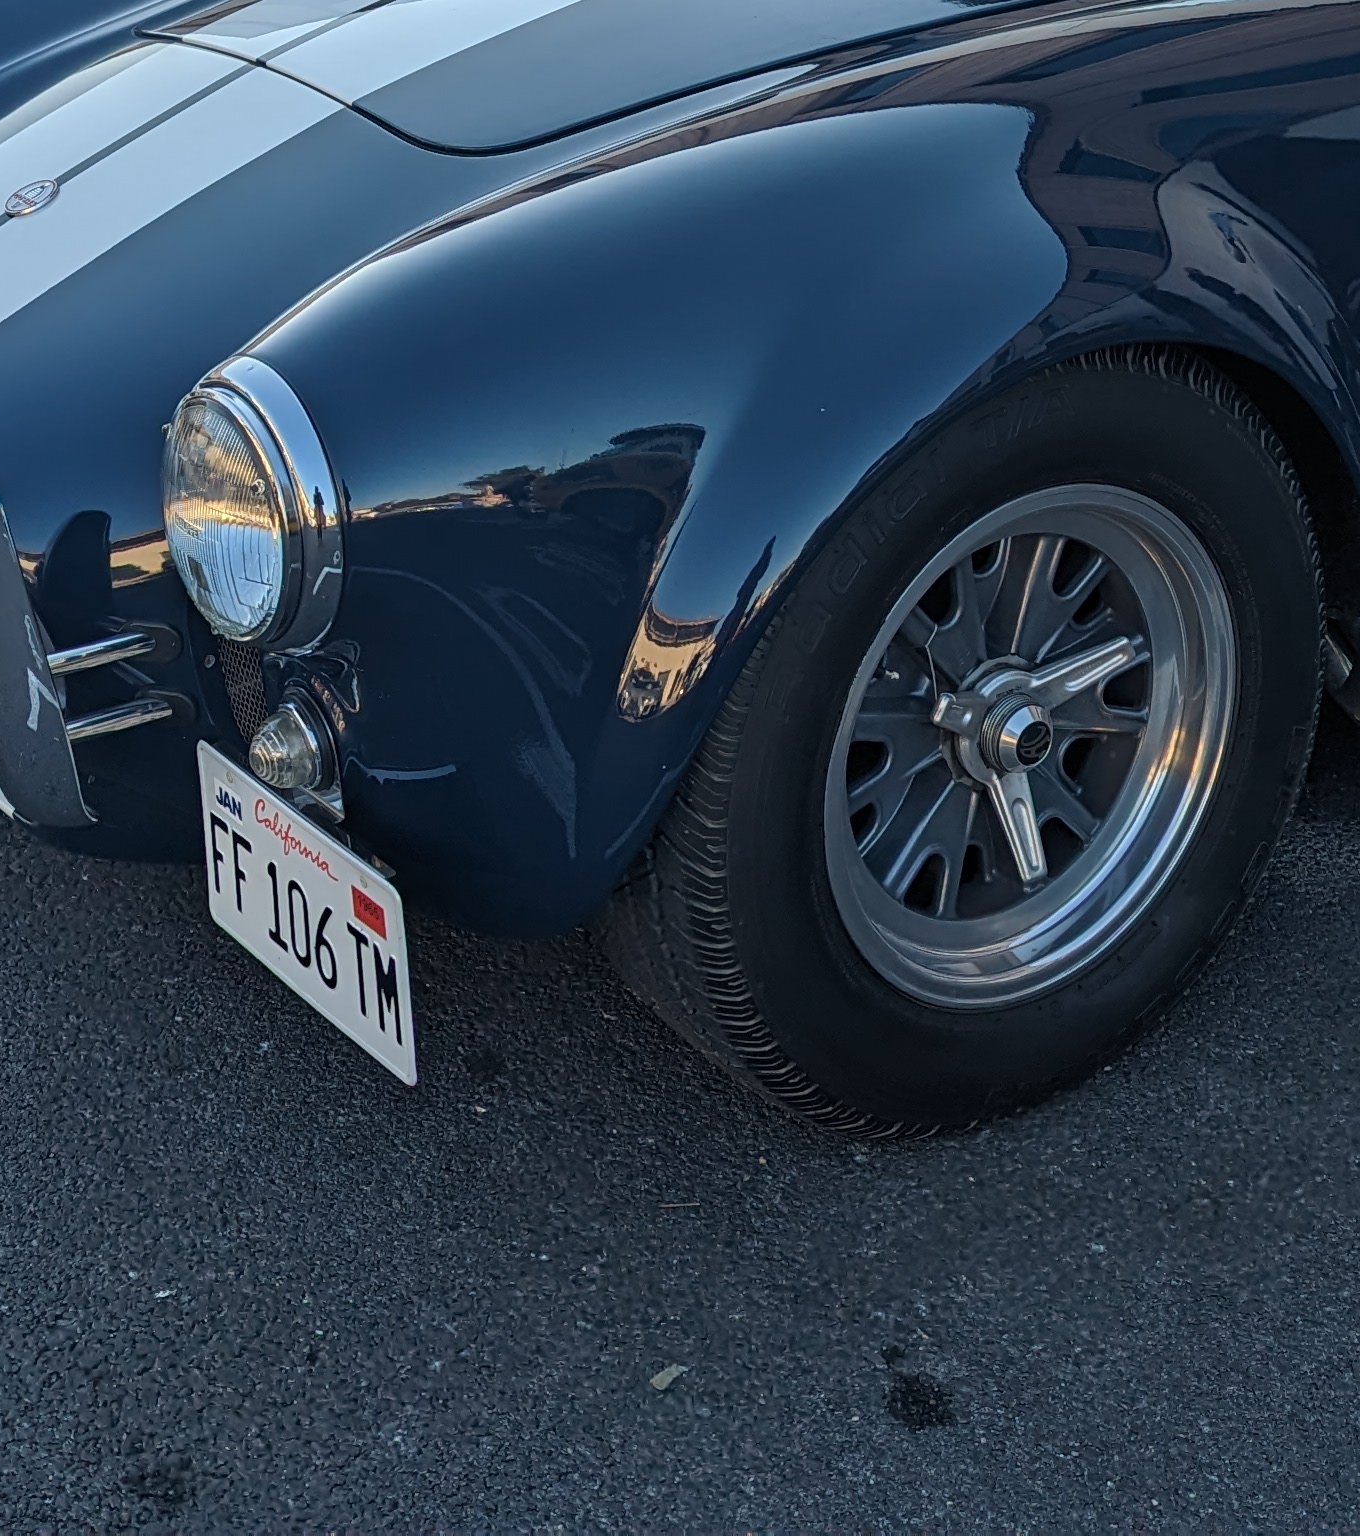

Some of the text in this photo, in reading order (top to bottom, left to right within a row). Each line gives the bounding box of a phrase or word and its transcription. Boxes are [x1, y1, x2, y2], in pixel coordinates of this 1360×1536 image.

[216, 785, 243, 822] JAN
[254, 798, 339, 882] California
[210, 811, 403, 1047] FF 106 TM
